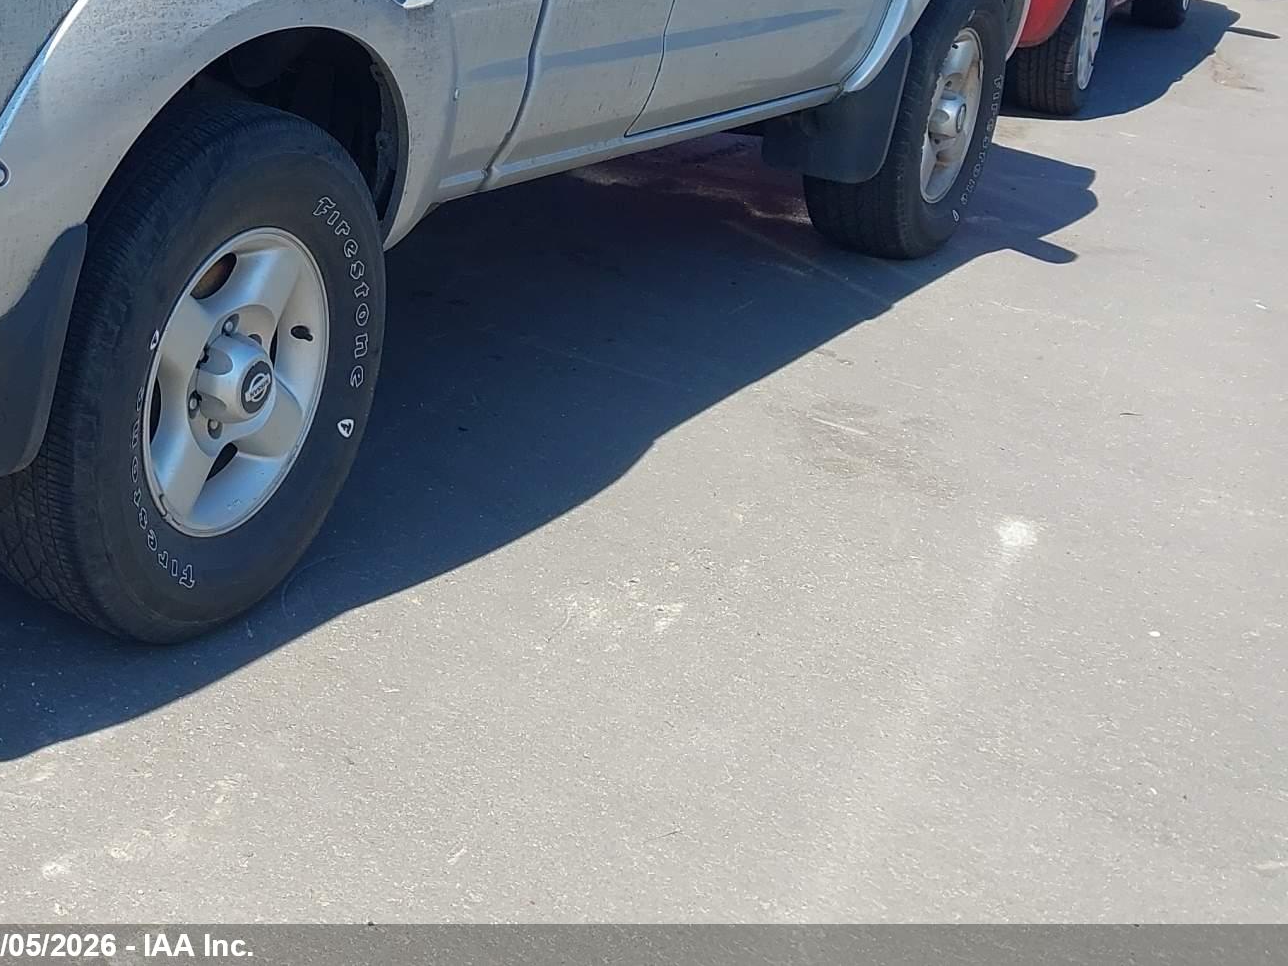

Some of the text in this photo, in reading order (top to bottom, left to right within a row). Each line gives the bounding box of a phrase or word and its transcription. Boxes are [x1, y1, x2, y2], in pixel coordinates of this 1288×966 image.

[960, 73, 1004, 206] Firestone
[312, 196, 370, 388] Firestone
[130, 386, 196, 589] Firestone
